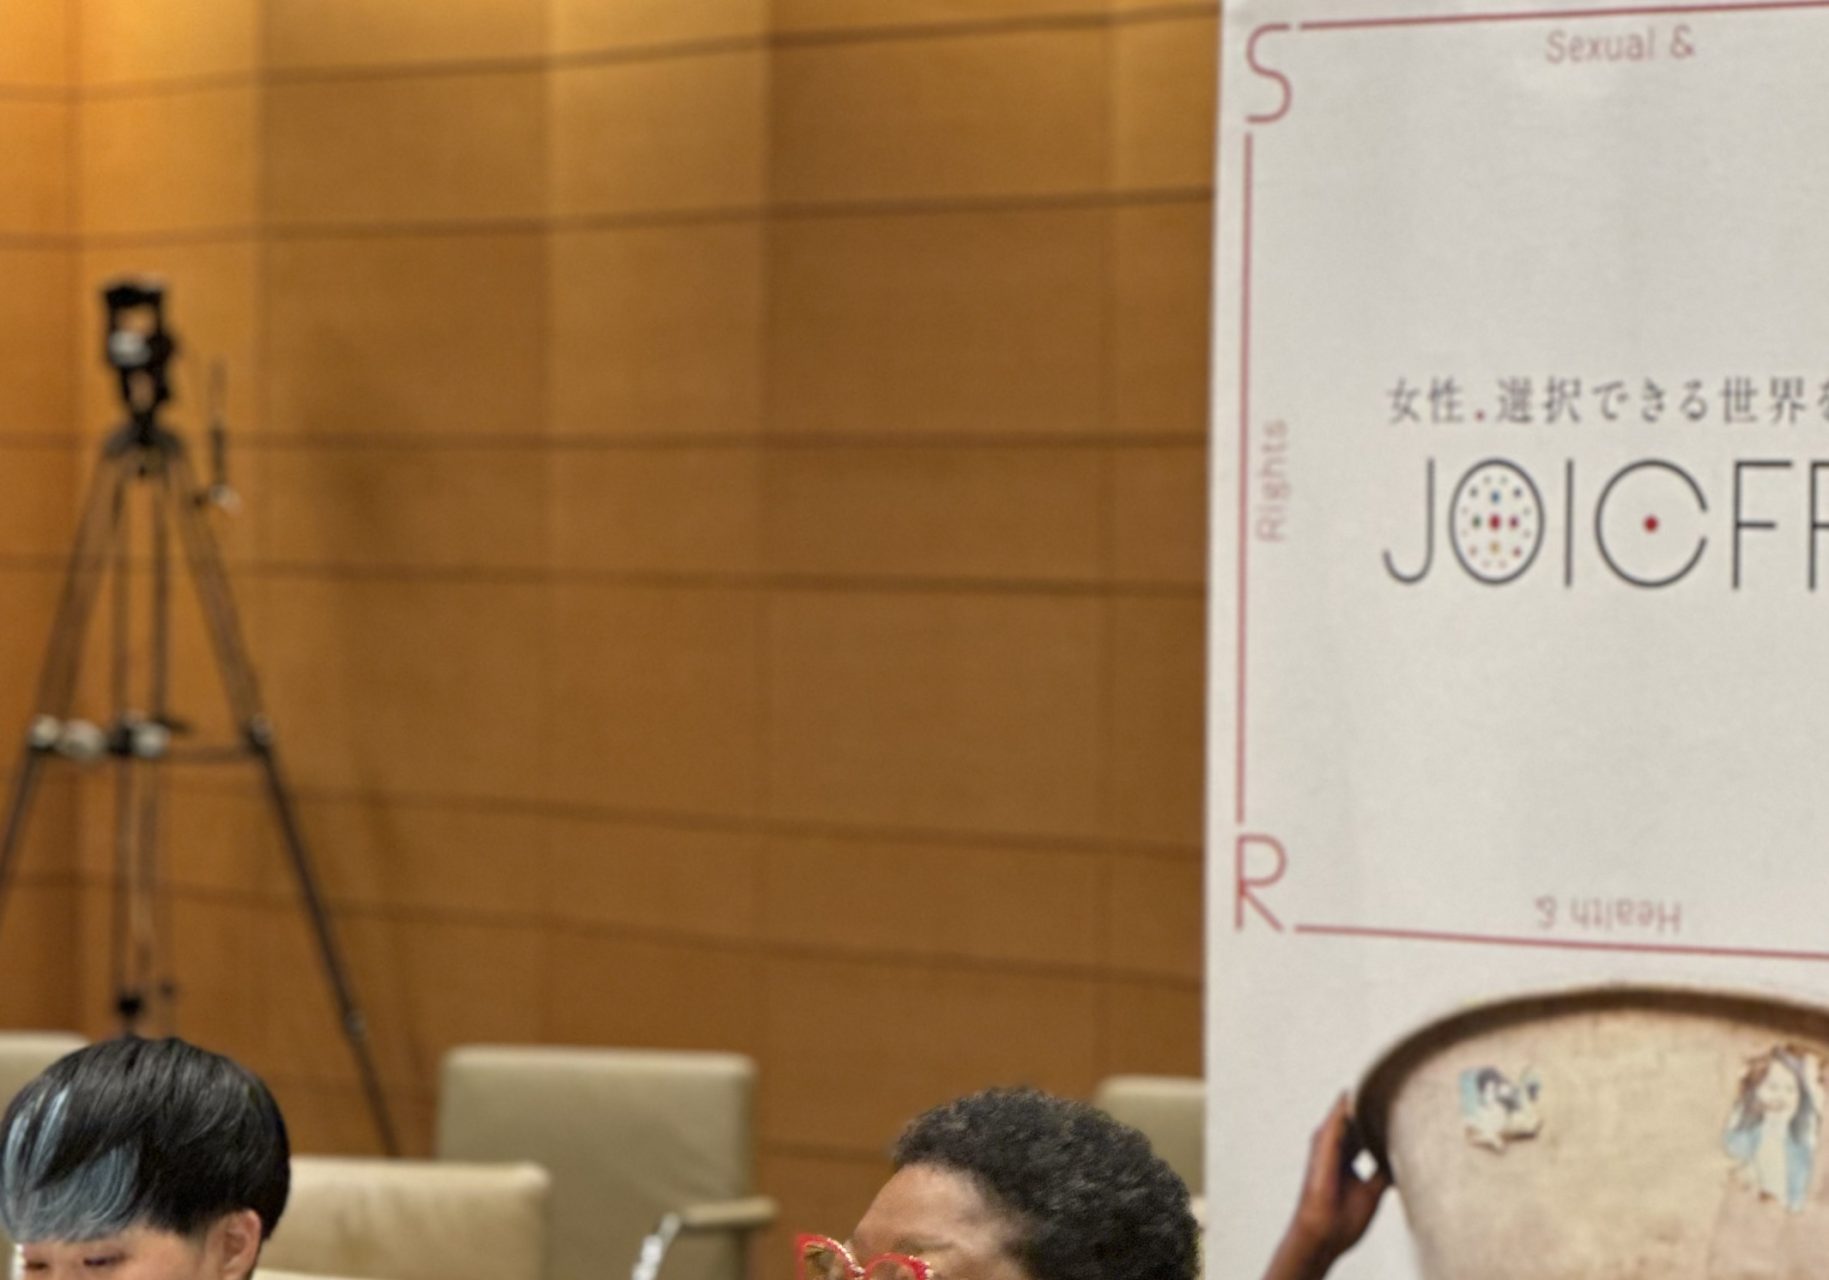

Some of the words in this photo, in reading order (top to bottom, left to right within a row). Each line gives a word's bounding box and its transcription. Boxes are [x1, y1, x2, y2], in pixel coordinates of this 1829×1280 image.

[1245, 23, 1292, 124] S
[1545, 28, 1656, 64] Sexual
[1669, 25, 1696, 59] &
[1256, 418, 1290, 543] Rights
[1234, 833, 1288, 933] R
[1571, 897, 1682, 935] Health
